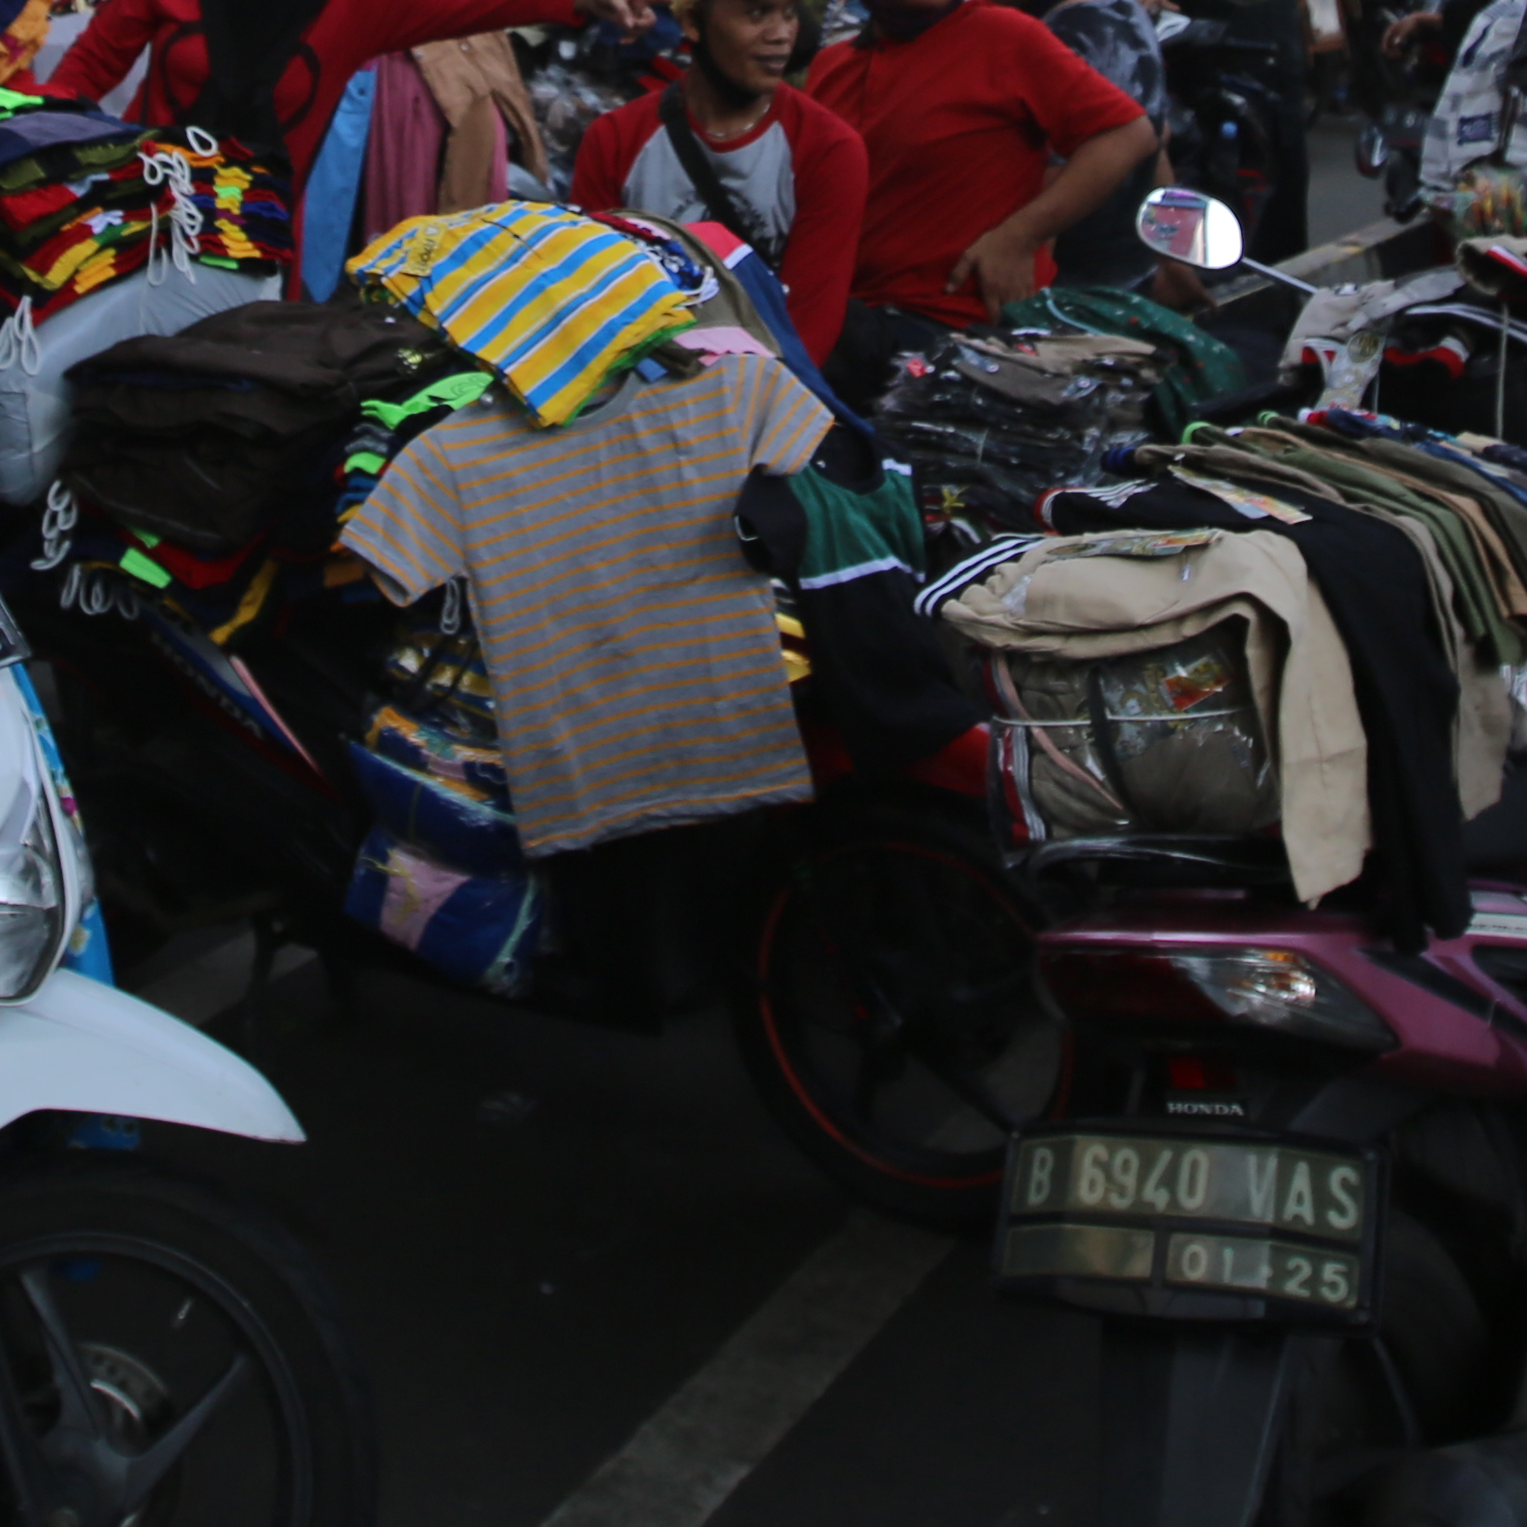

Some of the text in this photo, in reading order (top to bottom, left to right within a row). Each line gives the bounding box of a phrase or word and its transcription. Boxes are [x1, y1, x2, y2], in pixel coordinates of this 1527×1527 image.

[1167, 1102, 1244, 1116] HONDA
[1027, 1144, 1361, 1230] B 6940 VAS
